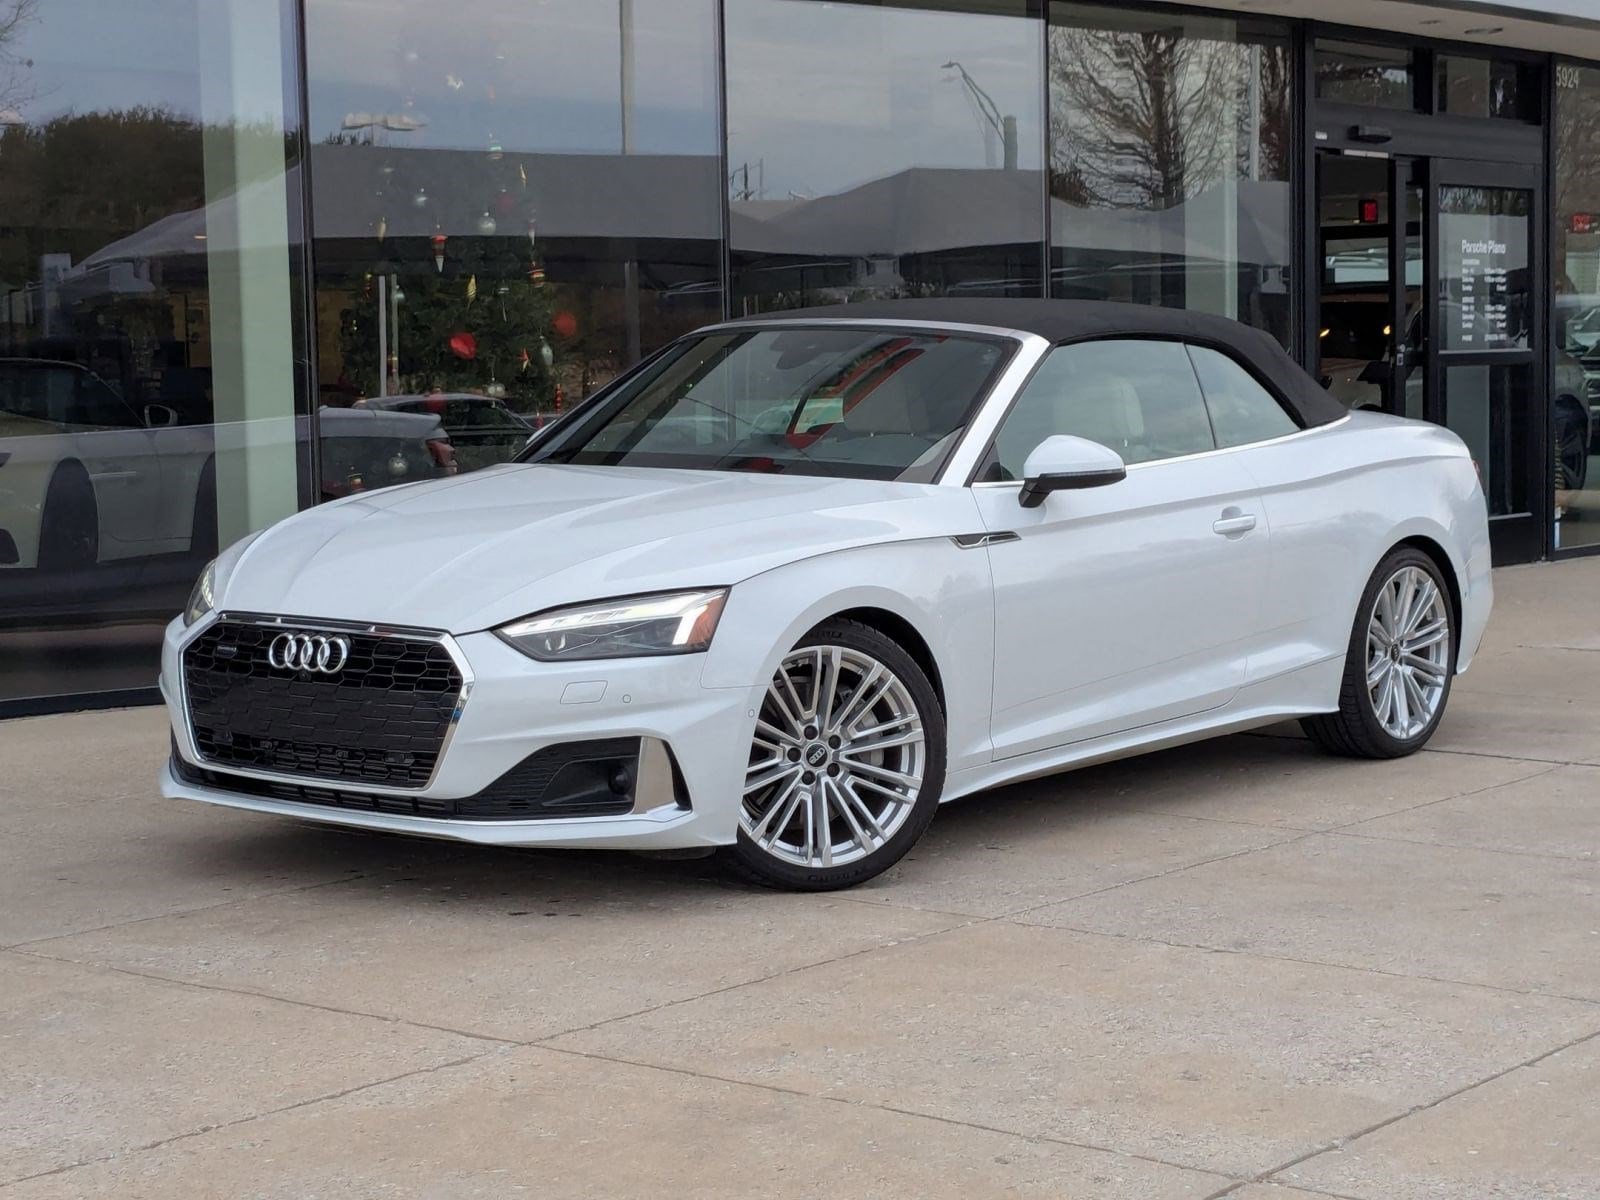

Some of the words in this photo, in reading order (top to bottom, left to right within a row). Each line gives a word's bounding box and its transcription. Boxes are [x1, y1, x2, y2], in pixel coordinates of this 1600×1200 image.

[1556, 66, 1579, 89] 5924
[1461, 240, 1487, 254] Porsche
[1487, 240, 1506, 254] Plano
